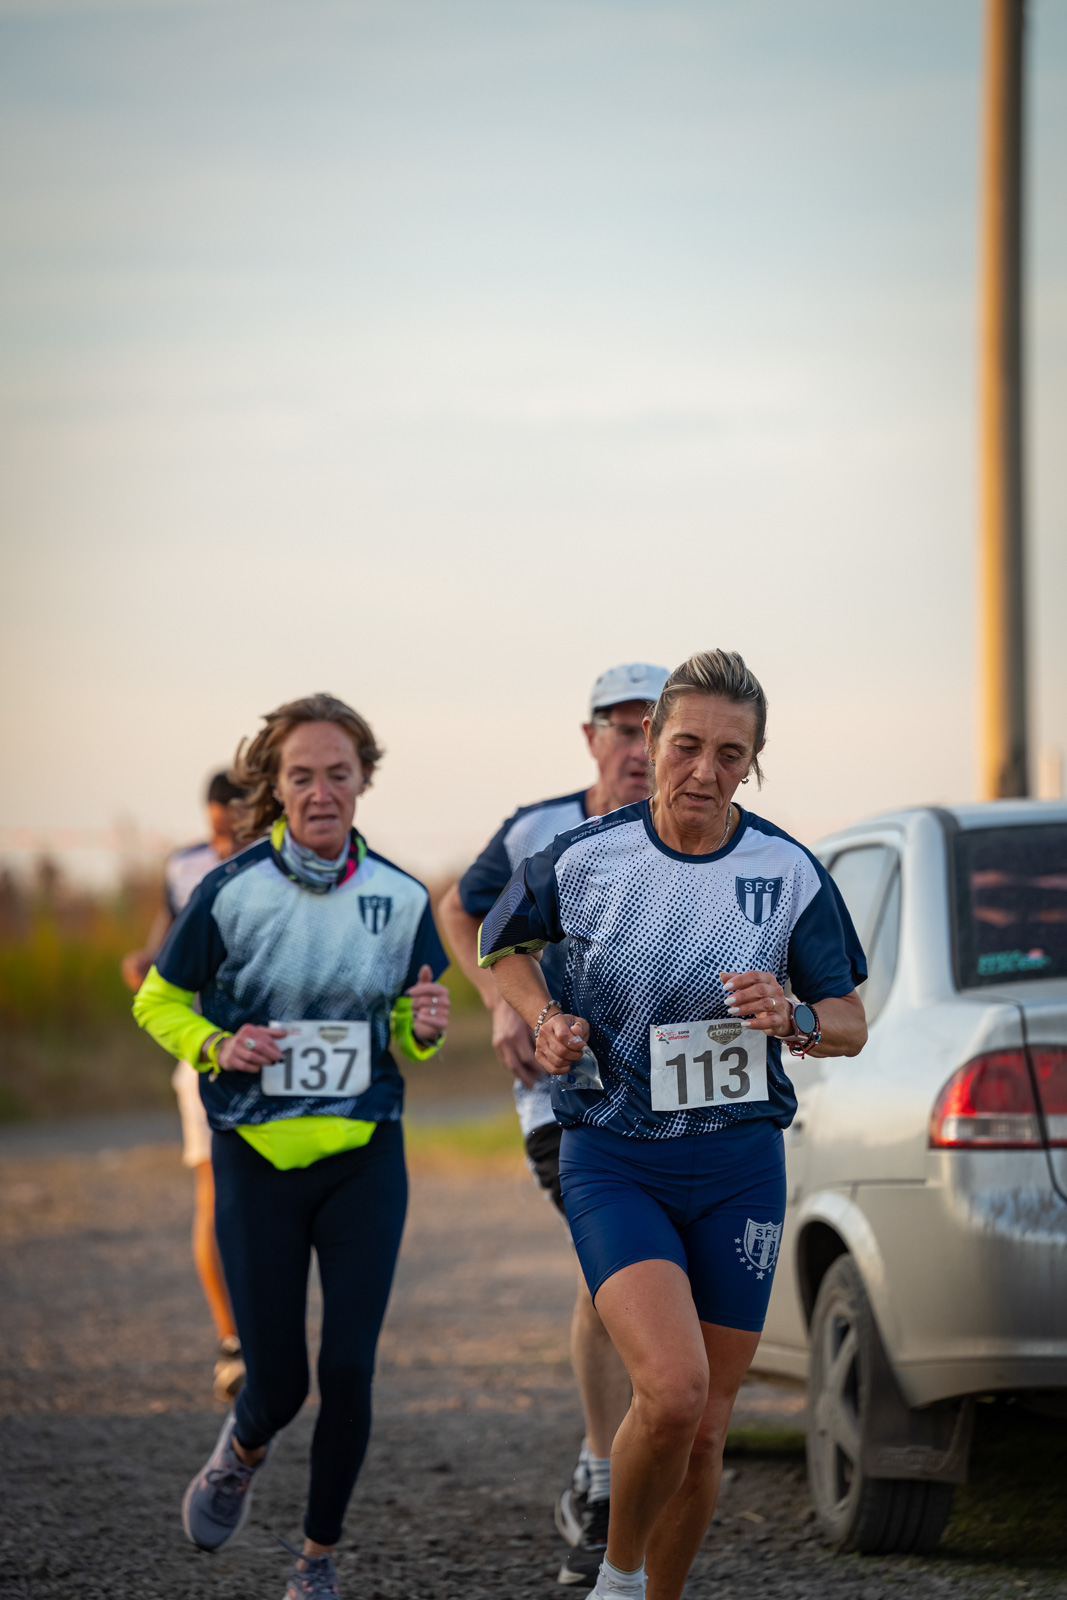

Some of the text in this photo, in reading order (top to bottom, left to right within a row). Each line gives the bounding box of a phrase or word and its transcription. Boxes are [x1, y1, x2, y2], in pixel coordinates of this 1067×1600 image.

[744, 881, 775, 892] SFC
[708, 1022, 742, 1030] ALVAREZ
[709, 1028, 741, 1037] CORRE
[282, 1047, 359, 1091] 137
[665, 1046, 751, 1105] 113
[755, 1228, 778, 1239] SFC
